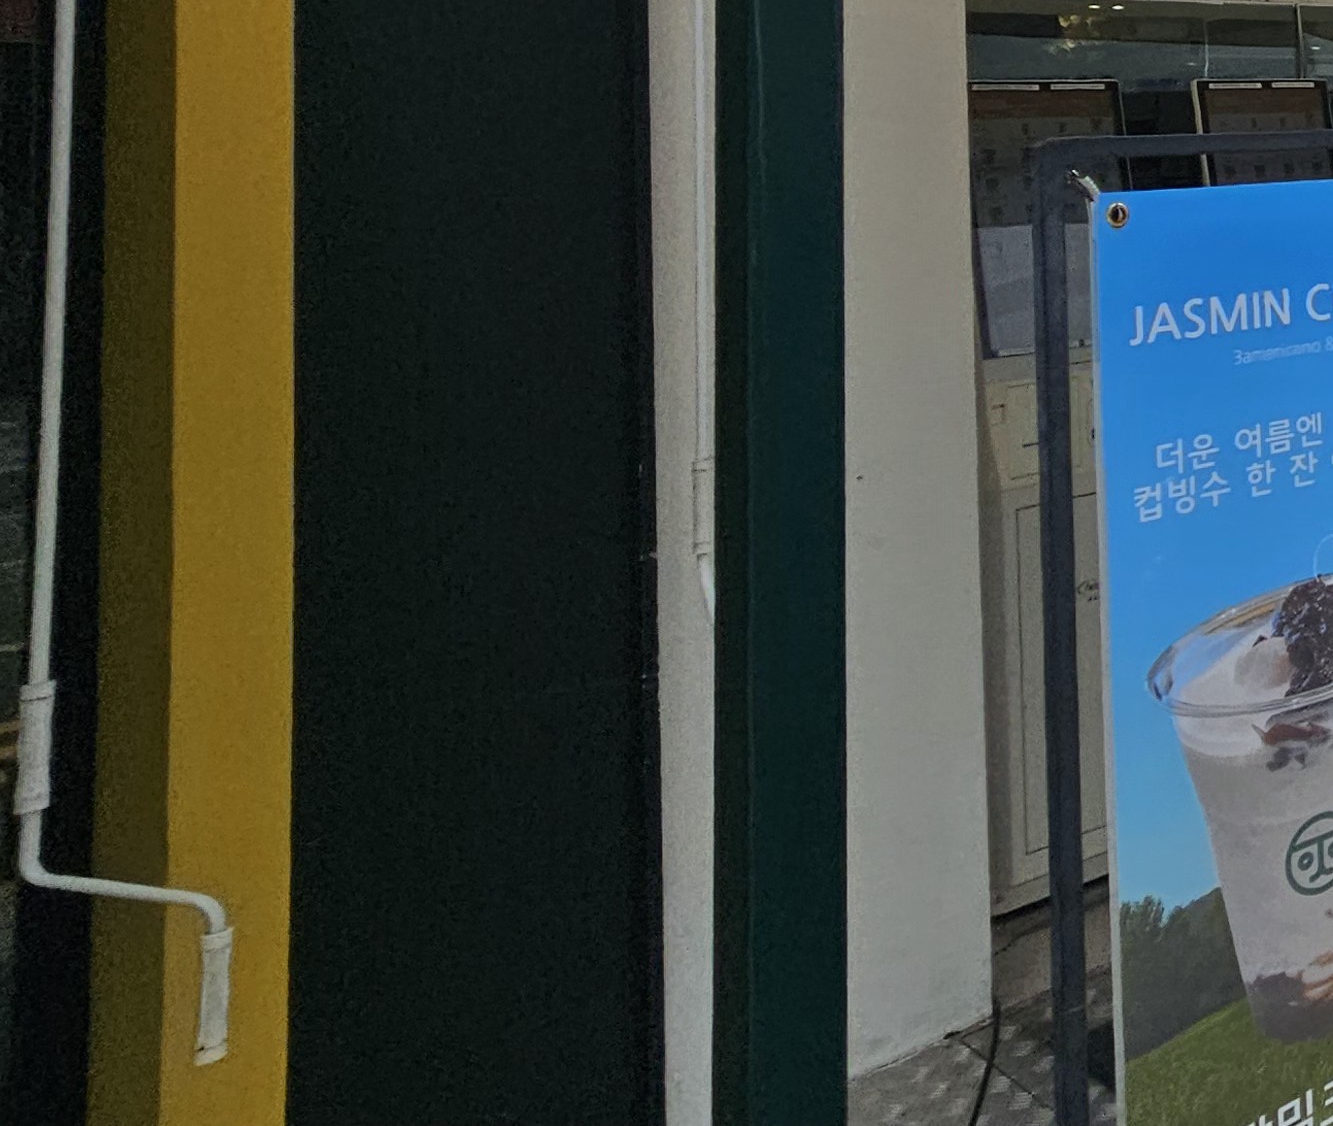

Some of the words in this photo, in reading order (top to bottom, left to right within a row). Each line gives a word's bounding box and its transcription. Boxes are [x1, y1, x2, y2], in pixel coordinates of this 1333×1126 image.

[1129, 287, 1291, 346] JASMIN
[1156, 434, 1220, 474] 더운
[1234, 412, 1323, 458] 여름엔
[1133, 476, 1230, 523] 컵빙수
[1247, 462, 1275, 498] 한
[1290, 454, 1318, 488] 잔
